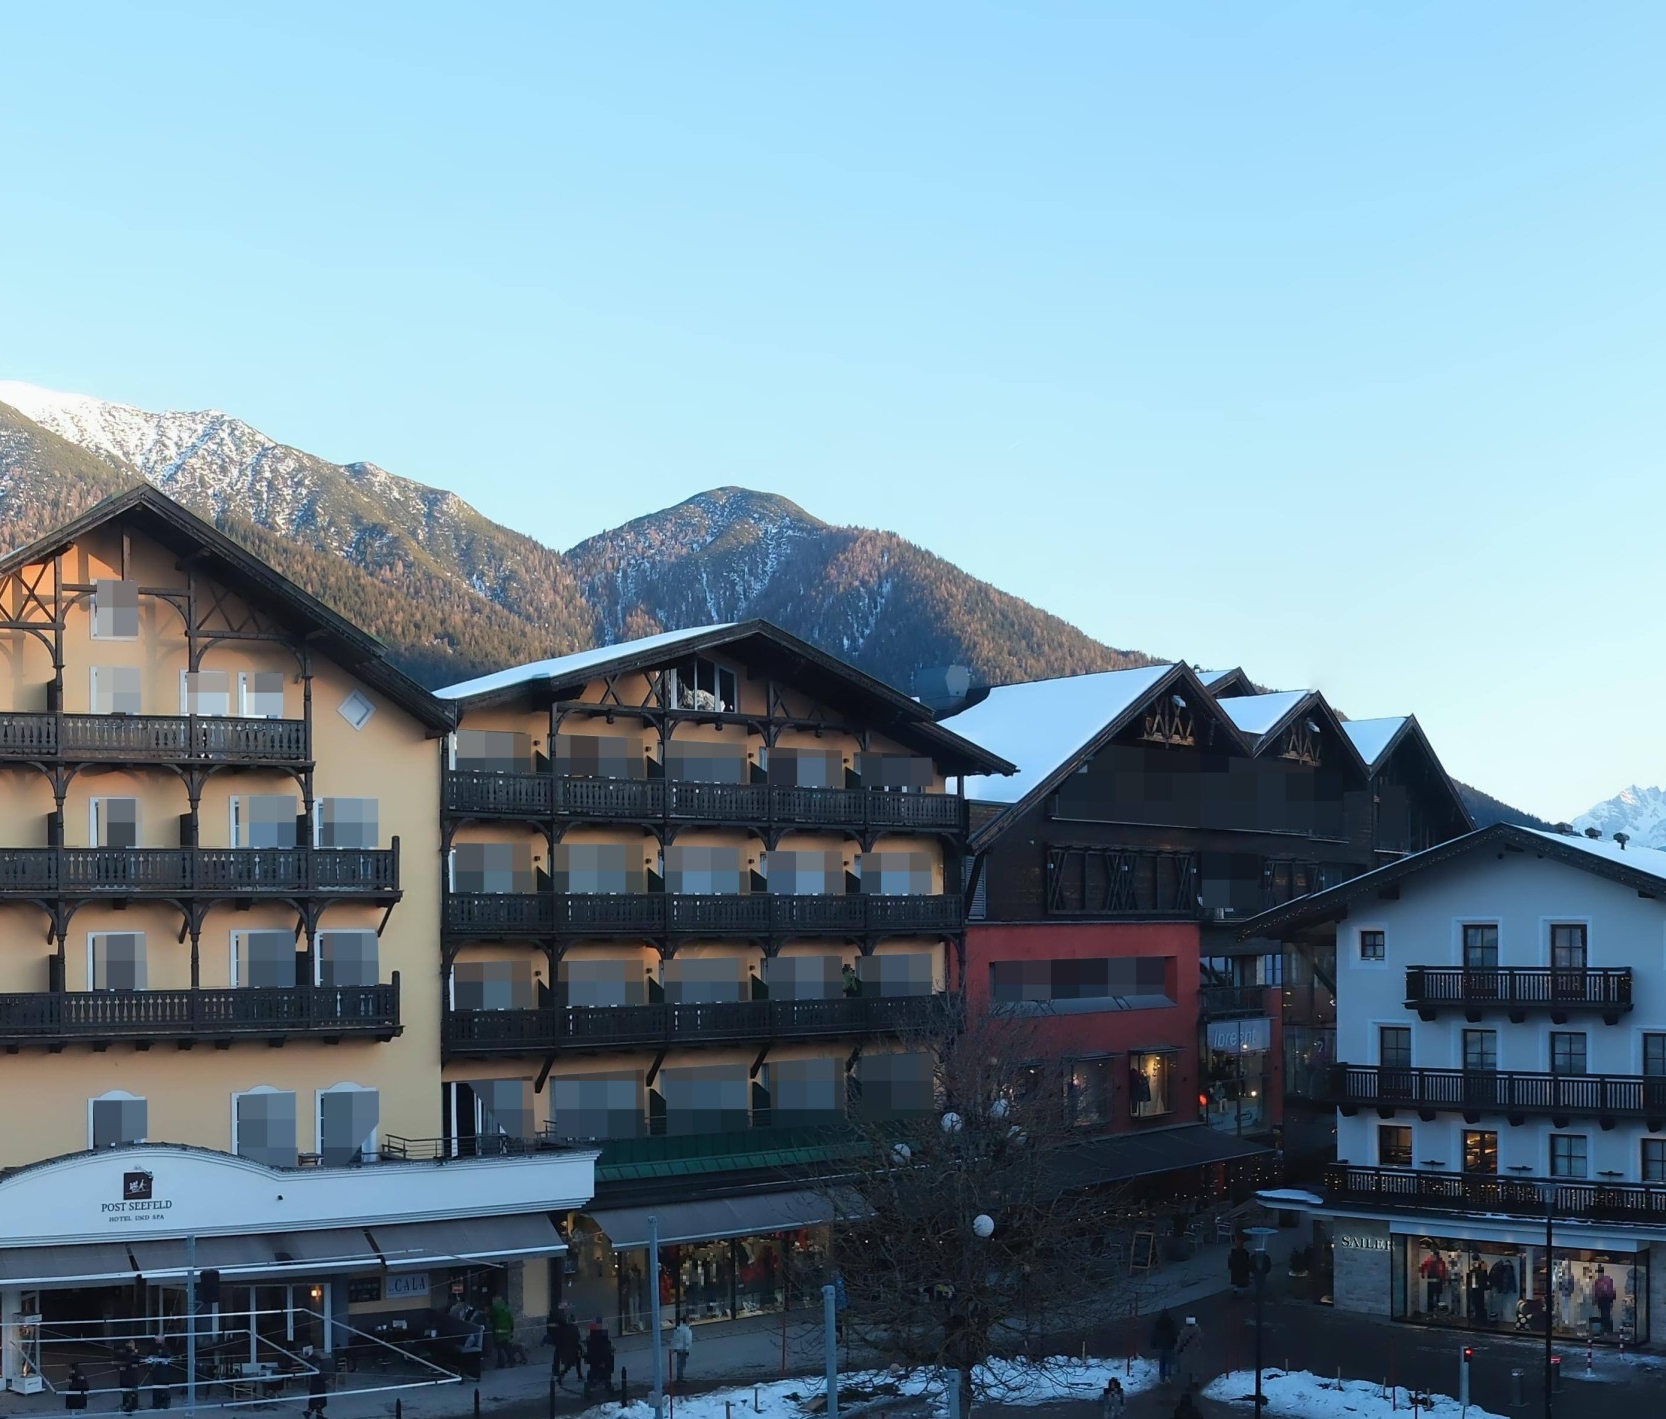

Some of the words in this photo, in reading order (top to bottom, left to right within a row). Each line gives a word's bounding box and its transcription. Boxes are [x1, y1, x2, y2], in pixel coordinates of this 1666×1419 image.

[101, 1203, 126, 1212] POST
[129, 1200, 172, 1211] SEEFELD
[1341, 1235, 1394, 1252] SAILER
[394, 1276, 426, 1293] CALA
